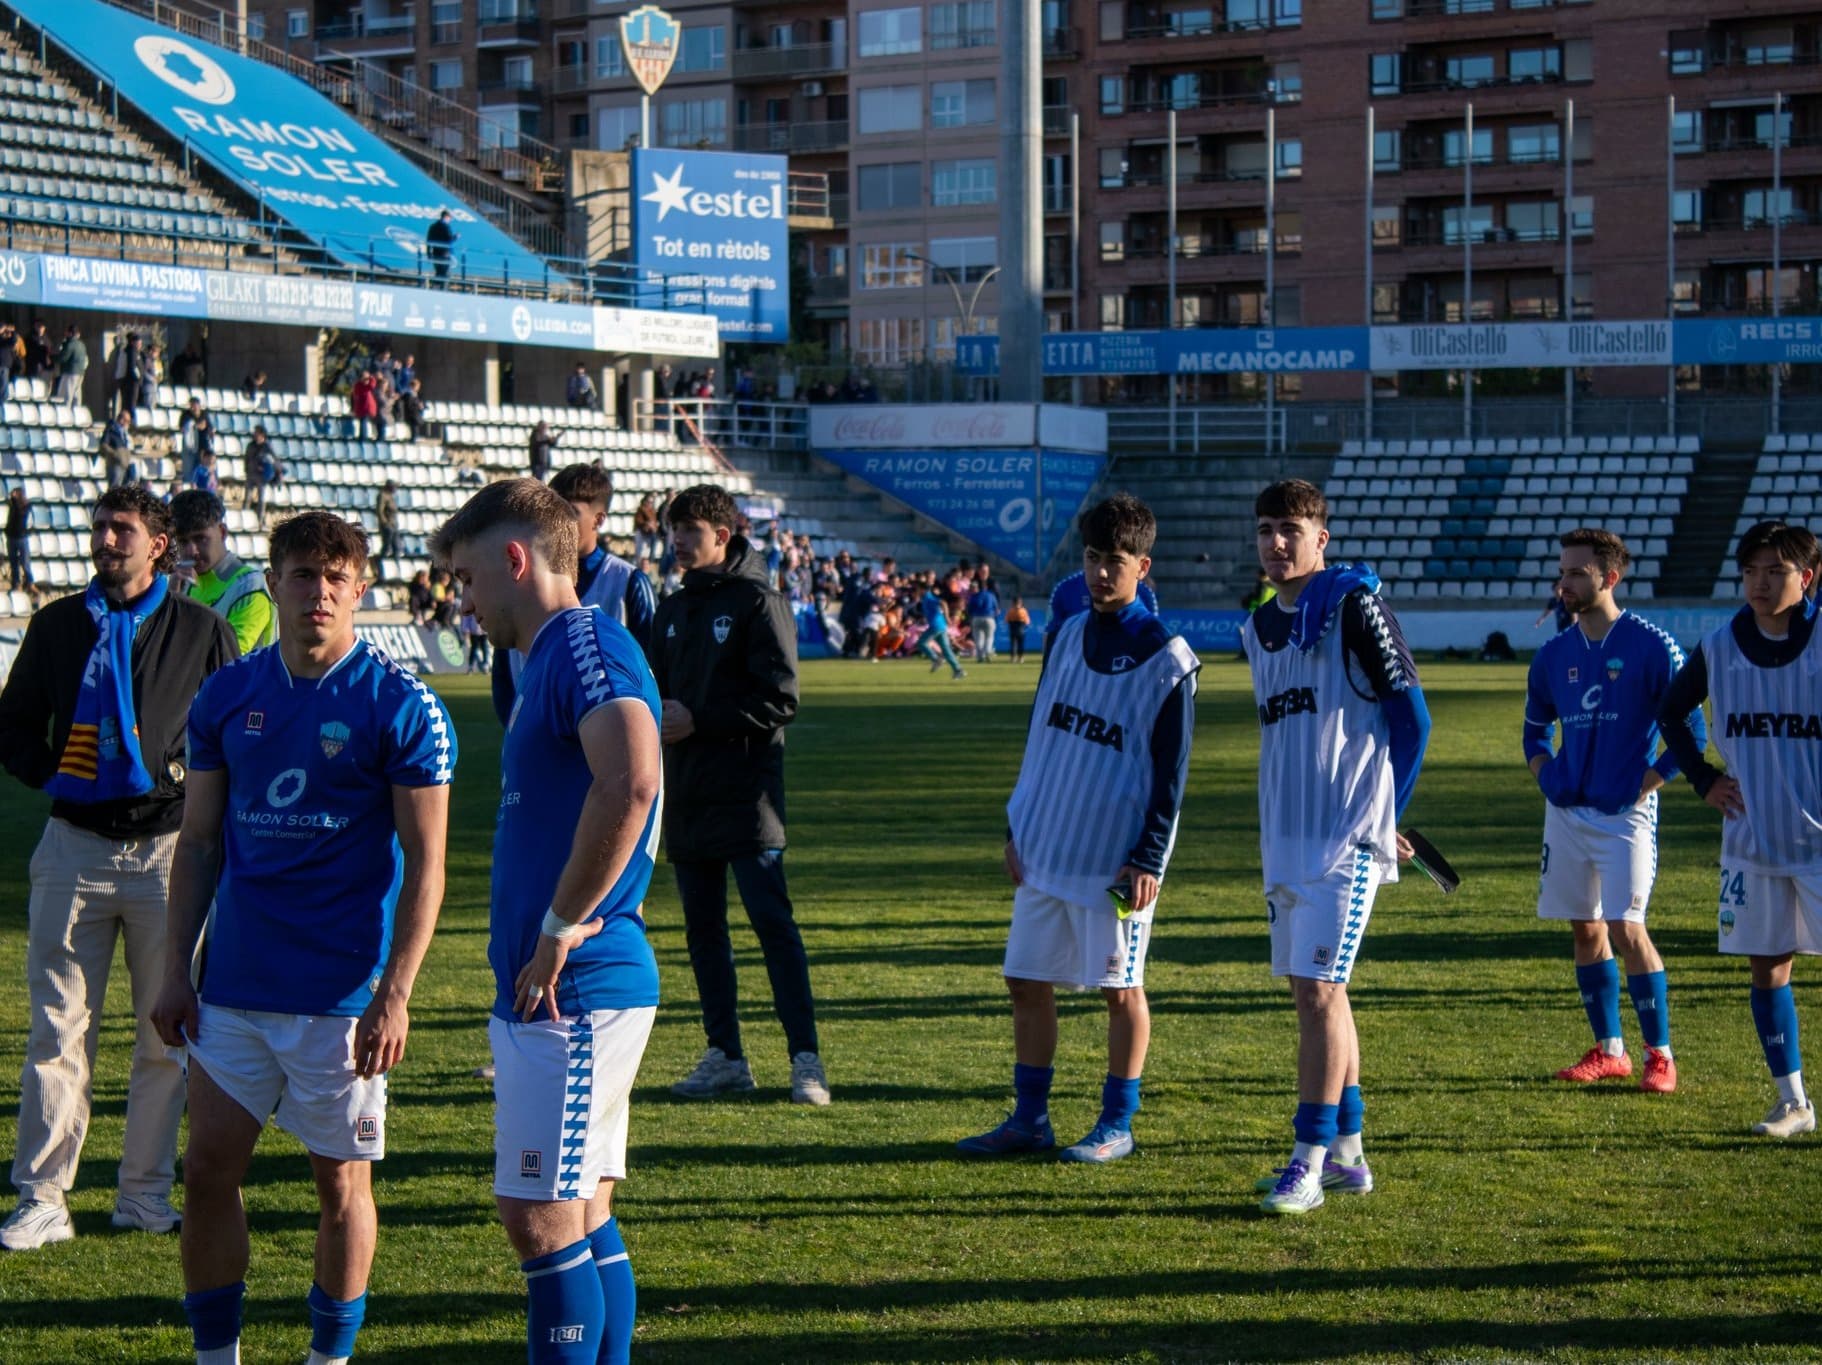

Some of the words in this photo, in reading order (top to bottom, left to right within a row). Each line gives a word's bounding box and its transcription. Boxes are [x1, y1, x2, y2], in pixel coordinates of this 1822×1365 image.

[172, 106, 357, 153] RAMON
[228, 145, 399, 187] SOLER
[690, 183, 785, 219] estel
[653, 236, 684, 257] Tot
[688, 242, 712, 259] en
[46, 256, 89, 283] FINCA
[92, 261, 142, 288] DIVINA
[144, 266, 203, 293] PASTORA
[647, 271, 727, 289] Imressions
[206, 276, 264, 304] GILART
[707, 291, 750, 307] format
[1411, 326, 1507, 358] OliCastelló
[1568, 324, 1667, 353] OliCastelló
[1741, 323, 1812, 340] RECS
[1178, 349, 1355, 371] MECANOCAMP
[865, 458, 948, 473] RAMON
[955, 457, 1033, 473] SOLER
[893, 477, 941, 490] Ferros
[954, 477, 1024, 490] Ferreteria
[1726, 712, 1822, 740] MEYBA
[287, 814, 349, 828] SOLER
[1719, 869, 1746, 906] 24
